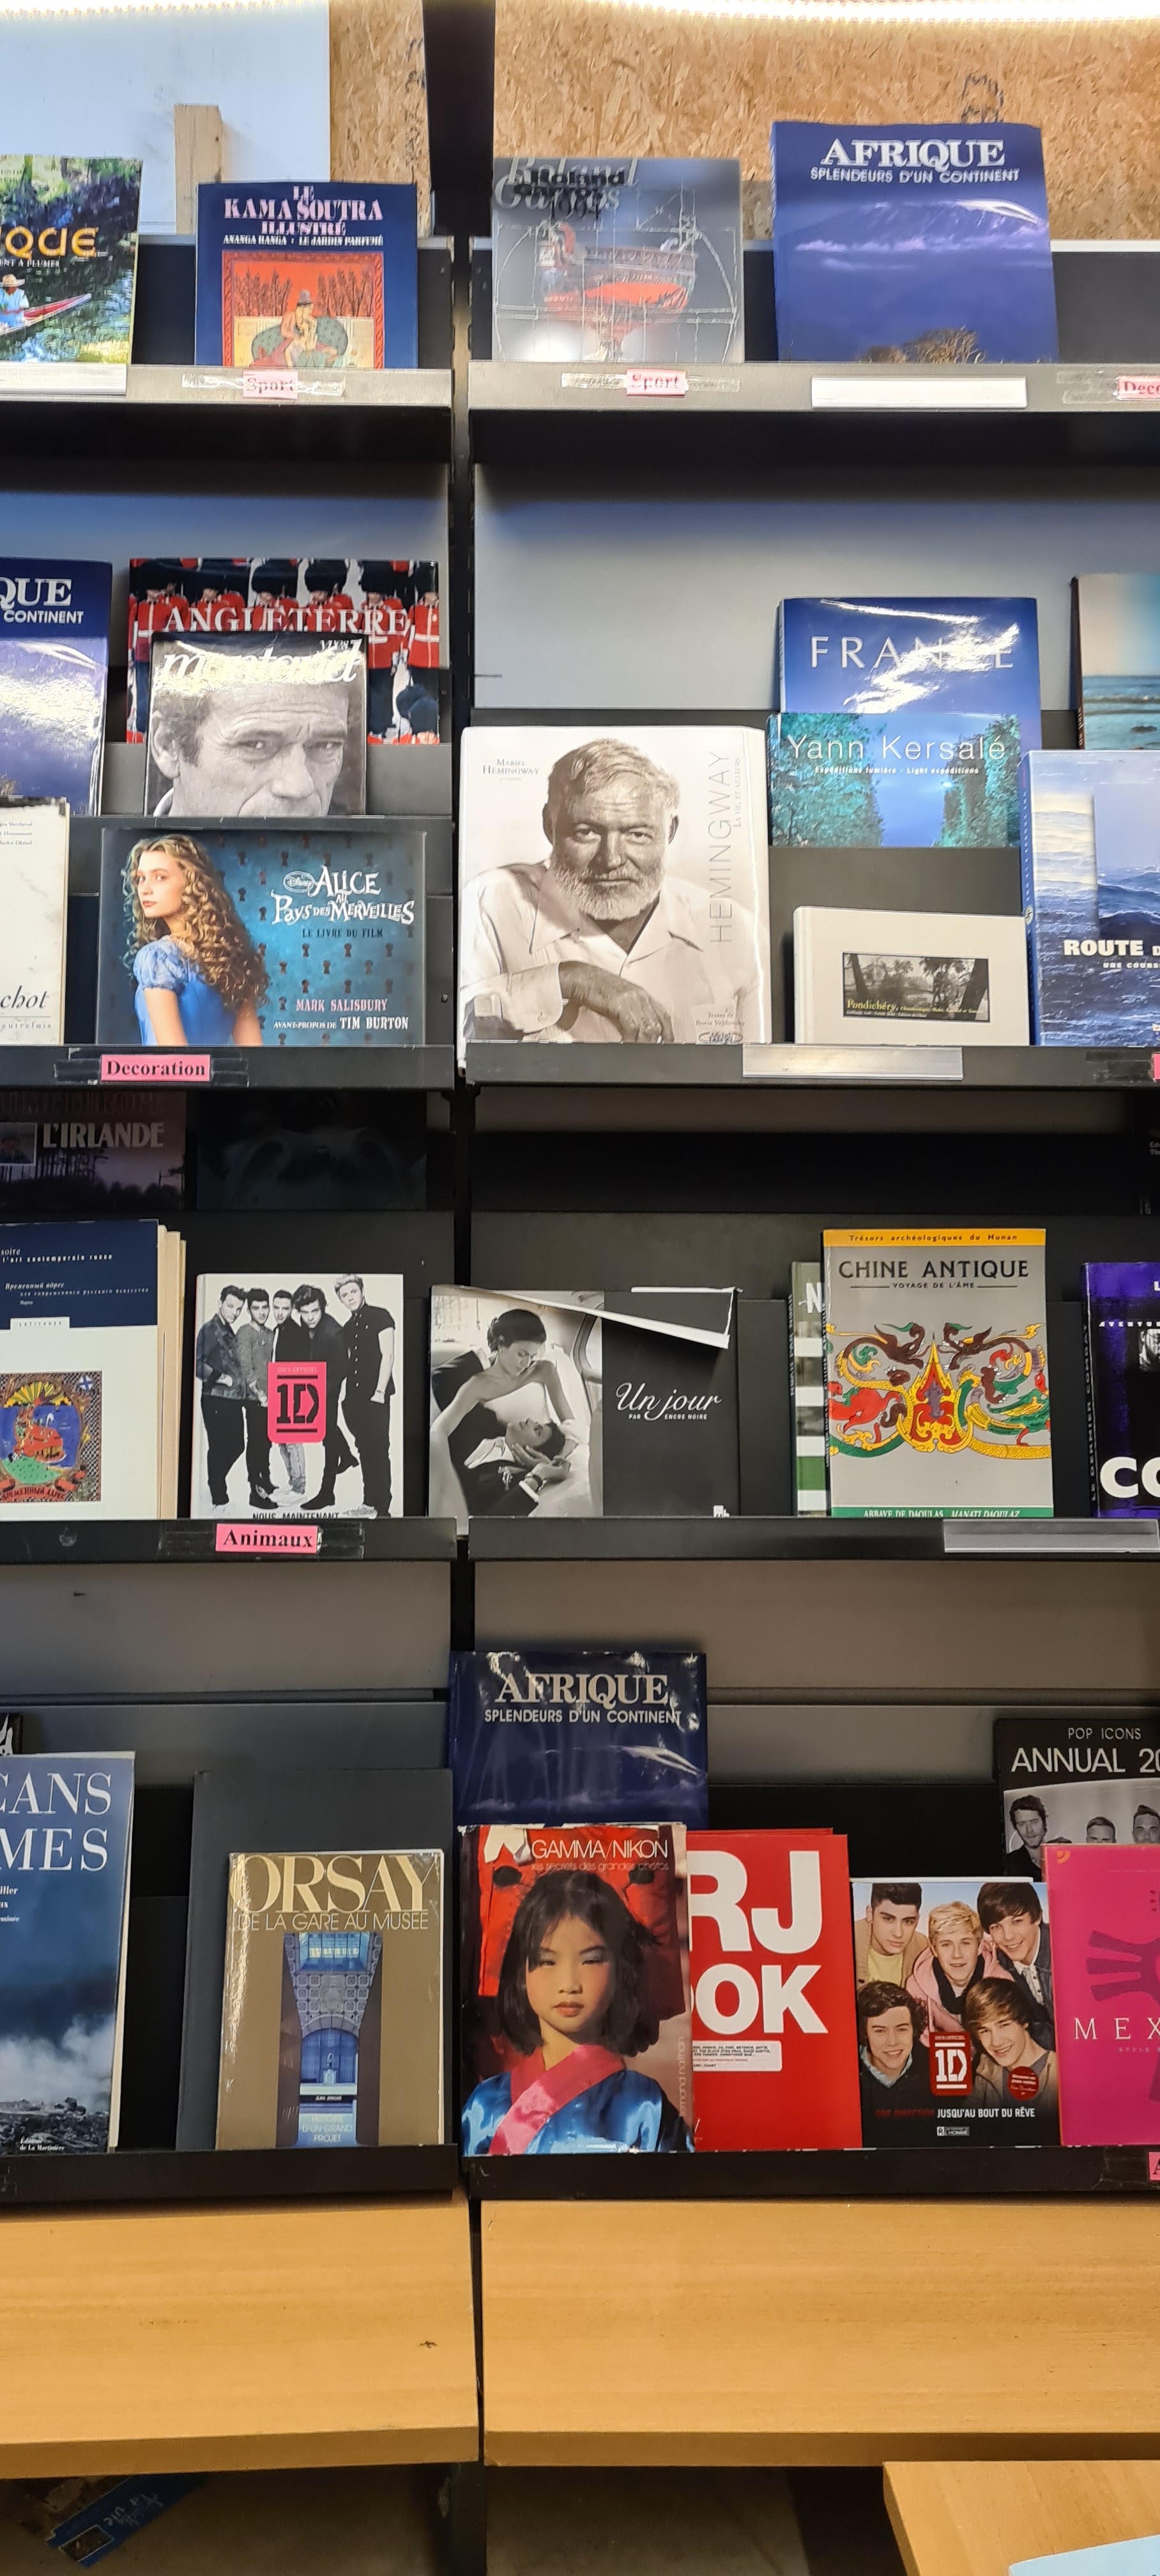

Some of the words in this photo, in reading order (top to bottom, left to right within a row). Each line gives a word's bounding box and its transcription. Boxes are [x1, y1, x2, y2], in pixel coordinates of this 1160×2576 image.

[820, 138, 1005, 172] AFRIQUE
[811, 167, 894, 183] SPLENDEURS
[899, 169, 933, 183] D'UN
[939, 168, 1020, 183] CONTINENT
[293, 185, 315, 201] LE
[224, 198, 293, 219] KAMA
[297, 199, 383, 221] SOUTRA
[261, 220, 346, 236] ILLUSTRÉ
[0, 225, 98, 259] QUE
[224, 234, 256, 245] ANANGA
[258, 234, 287, 245] RANGA
[299, 235, 309, 246] LE
[310, 235, 343, 246] JARDIN
[344, 234, 383, 246] PARFUMÉ
[247, 378, 294, 394] Sport
[632, 372, 683, 390] Sport
[4, 610, 84, 624] CONTINENT
[164, 606, 410, 636] ANGLETERRE
[787, 735, 864, 759] Yann
[883, 735, 1005, 760] Kersalé
[708, 751, 732, 944] HEMINGWAY
[308, 864, 382, 898] ALICE
[313, 905, 330, 917] DES
[328, 900, 415, 925] MERVEILLES
[302, 928, 313, 938] LE
[317, 928, 342, 938] LIVRE
[346, 928, 358, 938] DU
[362, 928, 383, 938] FILM
[1064, 939, 1144, 956] ROUTE
[296, 999, 325, 1012] MARK
[330, 999, 388, 1012] SALISBURY
[339, 1016, 361, 1030] TIM
[366, 1016, 409, 1031] BURTON
[106, 1060, 206, 1078] Decoration
[43, 1121, 164, 1148] L'IRLANDE
[890, 1233, 963, 1242] archéologiques
[839, 1261, 908, 1278] CHINE
[921, 1259, 1030, 1278] ANTIQUE
[948, 1280, 975, 1289] L'ÂME
[1083, 1324, 1091, 1395] COMBAT
[276, 1384, 319, 1425] 1D
[616, 1382, 661, 1411] Un
[644, 1389, 722, 1421] jour
[1087, 1401, 1095, 1477] DERNIER
[223, 1529, 313, 1548] Animaux
[494, 1673, 669, 1710] AFRIQUE
[484, 1709, 563, 1723] SPLENDEURS
[569, 1710, 600, 1723] D'UN
[606, 1710, 682, 1724] CONTINENT
[1068, 1728, 1093, 1740] POP
[1101, 1728, 1141, 1740] ICONS
[1011, 1747, 1126, 1773] ANNUAL
[531, 1839, 668, 1860] GAMMA/NIKON
[546, 1862, 576, 1871] secrets
[579, 1862, 596, 1871] des
[598, 1862, 635, 1873] grandes
[229, 1854, 439, 1914] ORSAY
[238, 1913, 259, 1931] DE
[266, 1913, 286, 1931] LA
[293, 1913, 339, 1931] GARE
[346, 1912, 368, 1931] AU
[690, 1963, 828, 2035] OK
[1074, 2017, 1160, 2040] MEX
[935, 2049, 968, 2082] 1D
[937, 2108, 976, 2119] JUSQU'AU
[978, 2108, 998, 2118] BOUT
[1002, 2108, 1013, 2118] DU
[1015, 2106, 1035, 2118] RÊVE
[314, 2133, 341, 2142] PROJET
[324, 2124, 353, 2133] GRAND
